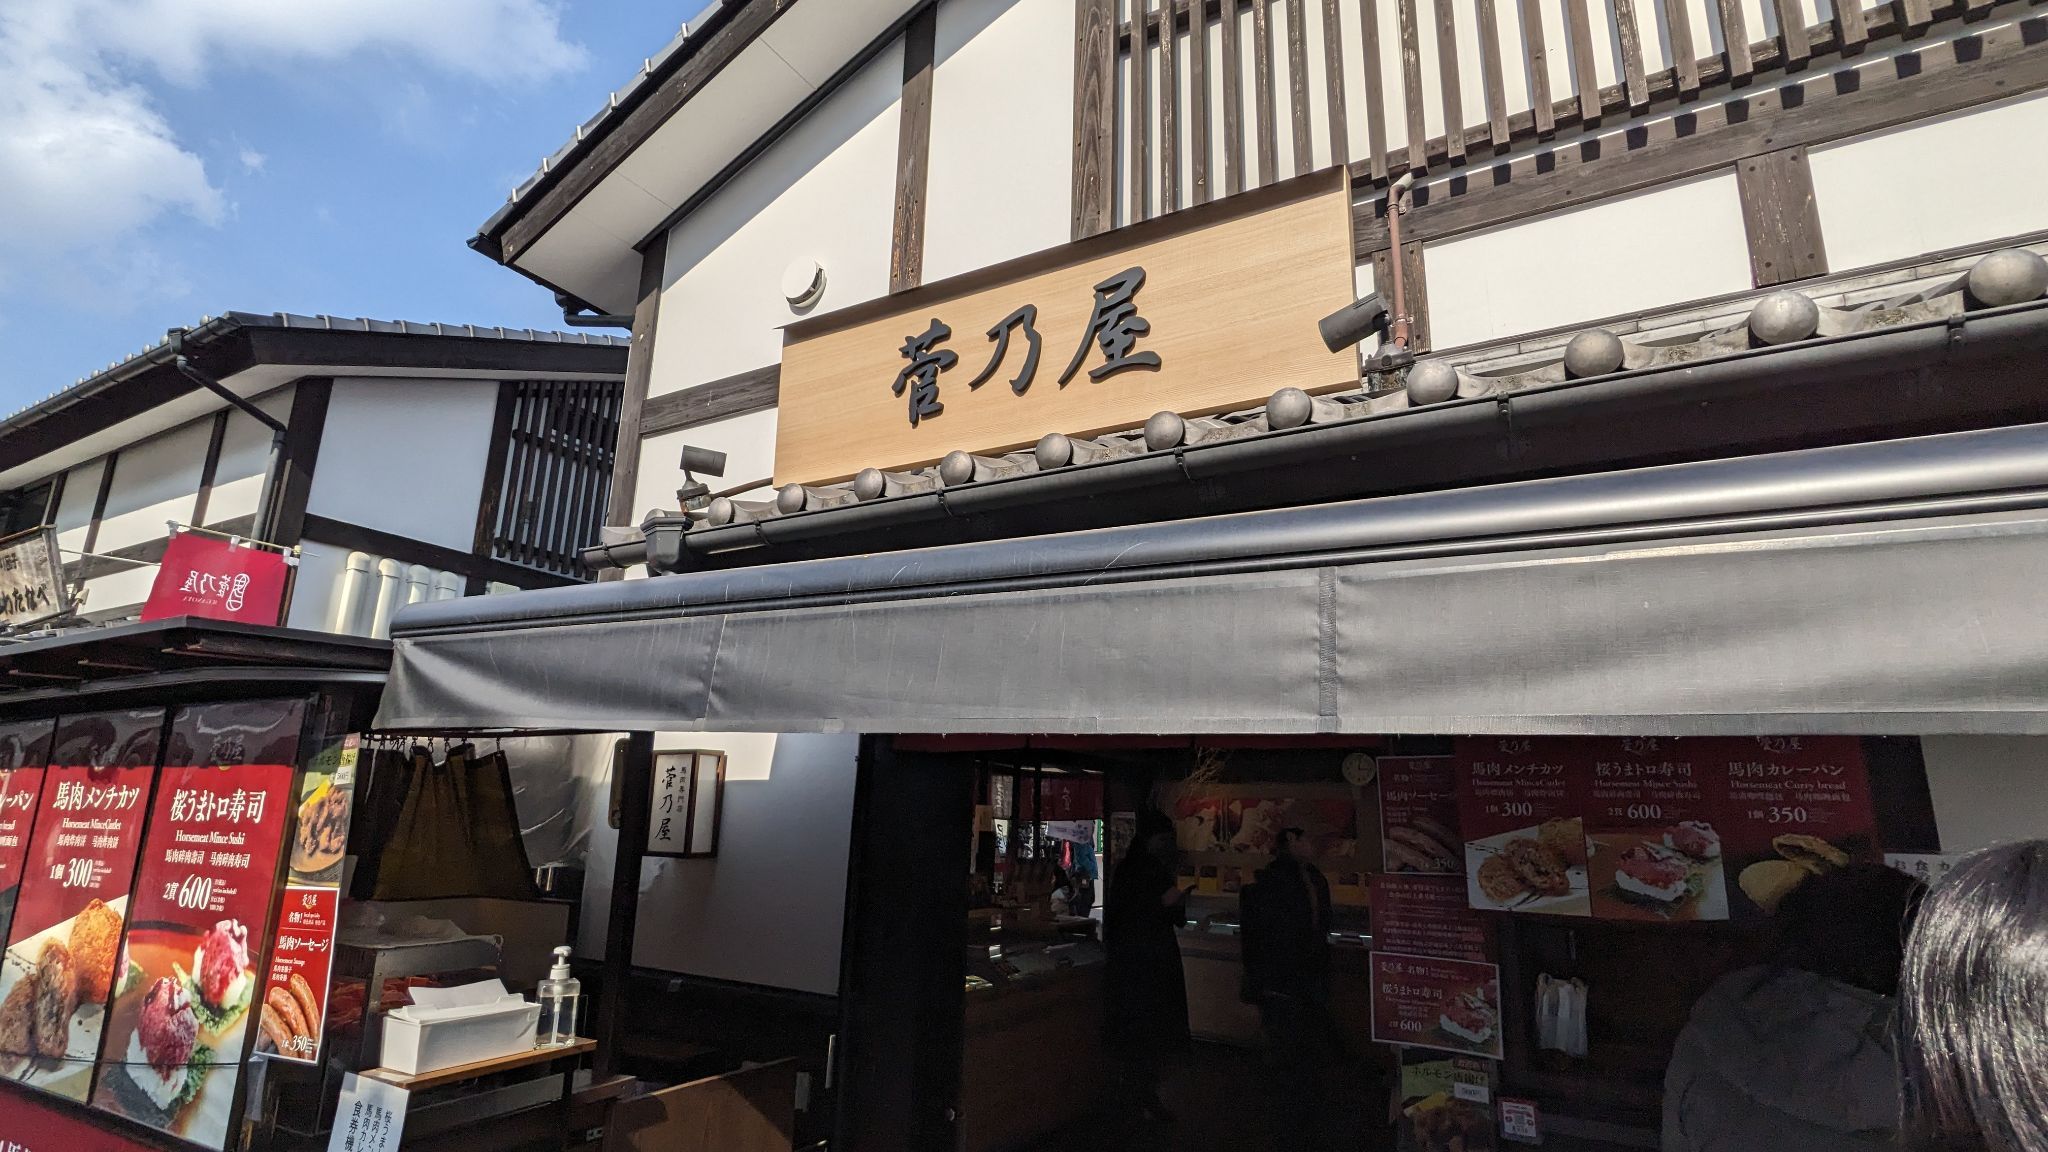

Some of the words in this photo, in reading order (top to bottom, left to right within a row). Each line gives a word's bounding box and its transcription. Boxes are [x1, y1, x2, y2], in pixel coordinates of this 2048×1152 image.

[892, 266, 1161, 426] 菅乃屋
[1472, 761, 1563, 776] 馬肉メンチカツ
[1595, 761, 1691, 777] 桜うまトロ寿司
[1728, 761, 1844, 777] 馬肉カレーパン
[1730, 780, 1782, 790] Horsemeat
[1784, 780, 1815, 792] Curry
[1816, 780, 1846, 790] bread
[53, 781, 140, 811] 馬肉メンチカツ
[655, 766, 676, 841] 菅乃屋
[170, 788, 267, 824] 桜うまトロ寿司
[1501, 801, 1533, 817] 300
[1626, 804, 1662, 819] 600
[1768, 806, 1807, 823] 350
[175, 829, 209, 843] Horsemeat
[209, 831, 228, 844] Mince
[228, 832, 246, 845] Sushi
[50, 864, 65, 880] 1個
[63, 857, 93, 888] 300
[178, 873, 212, 910] 600
[277, 935, 329, 953] 馬肉ソーセージ
[1400, 1018, 1423, 1033] 600
[289, 1035, 308, 1051] 350
[377, 1109, 393, 1152] 桜うま
